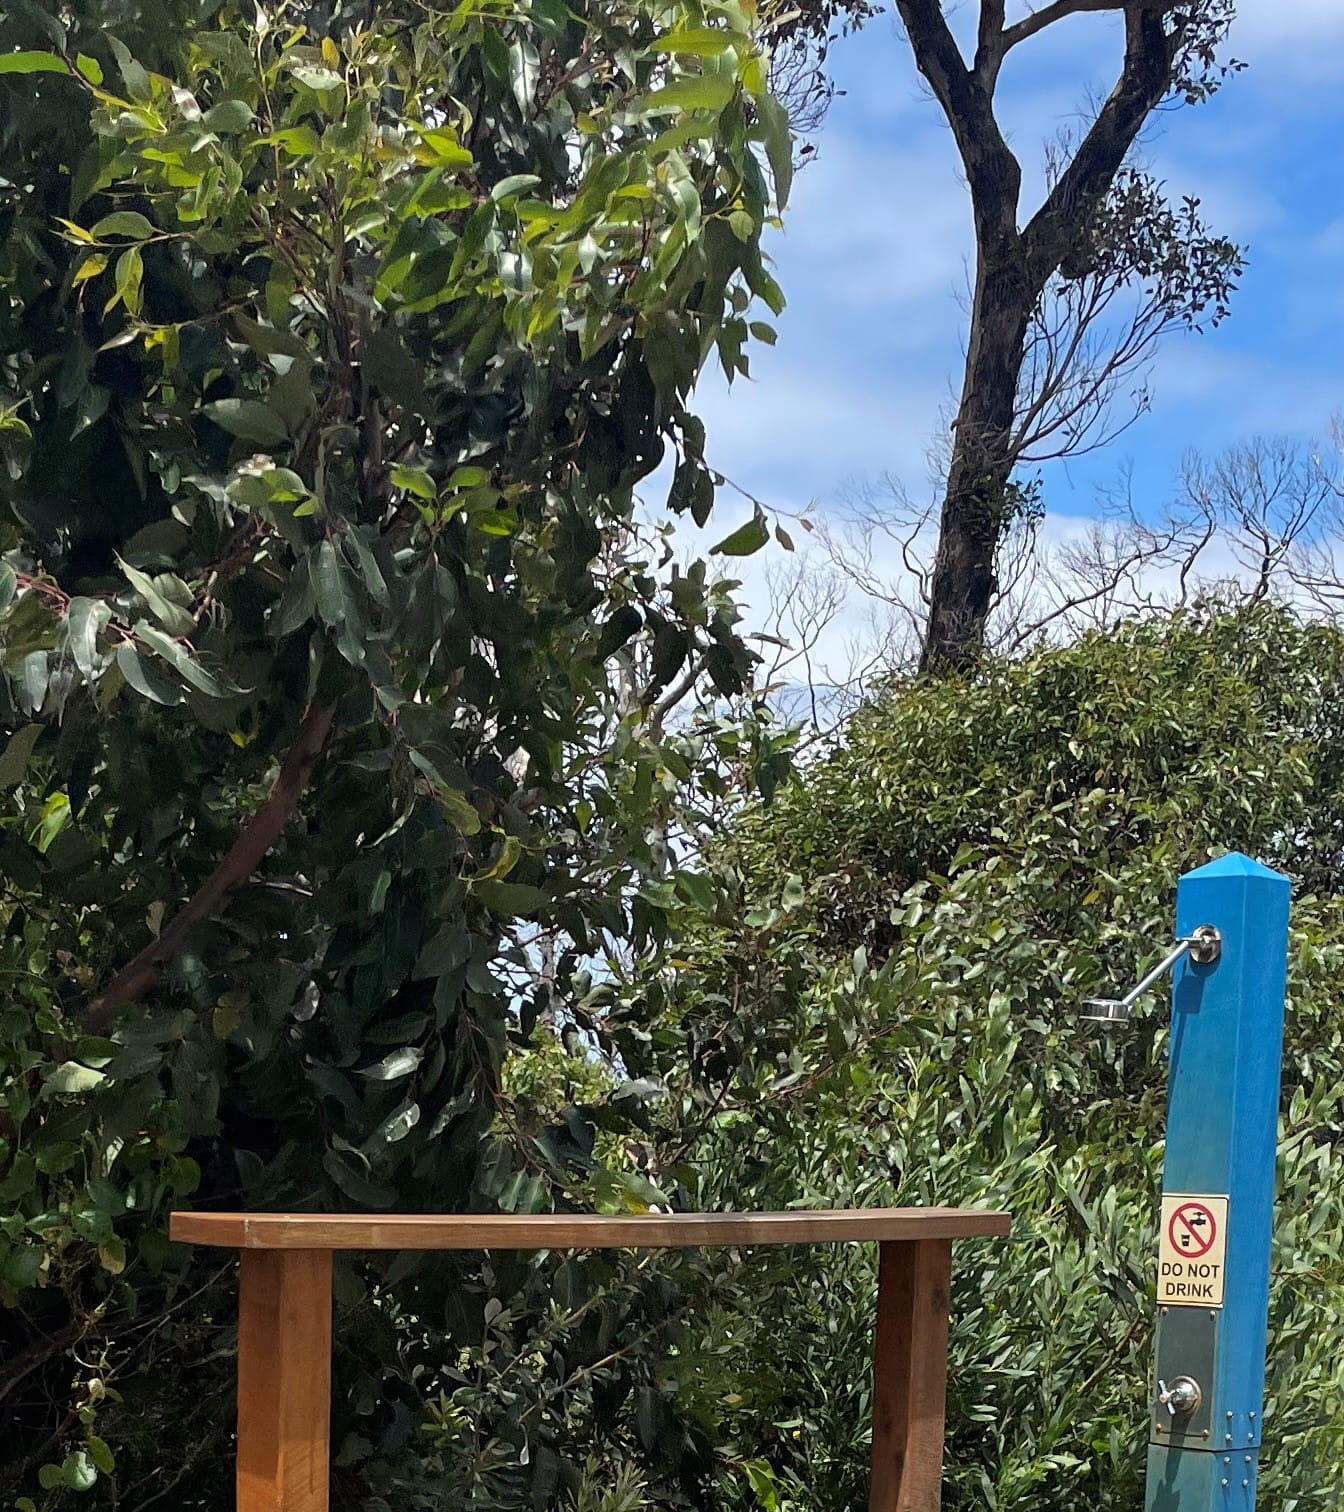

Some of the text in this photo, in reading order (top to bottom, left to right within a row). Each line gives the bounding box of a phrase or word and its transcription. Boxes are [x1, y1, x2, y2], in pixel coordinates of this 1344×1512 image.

[1161, 1262, 1220, 1279] DO NOT
[1165, 1282, 1213, 1298] DRINK
